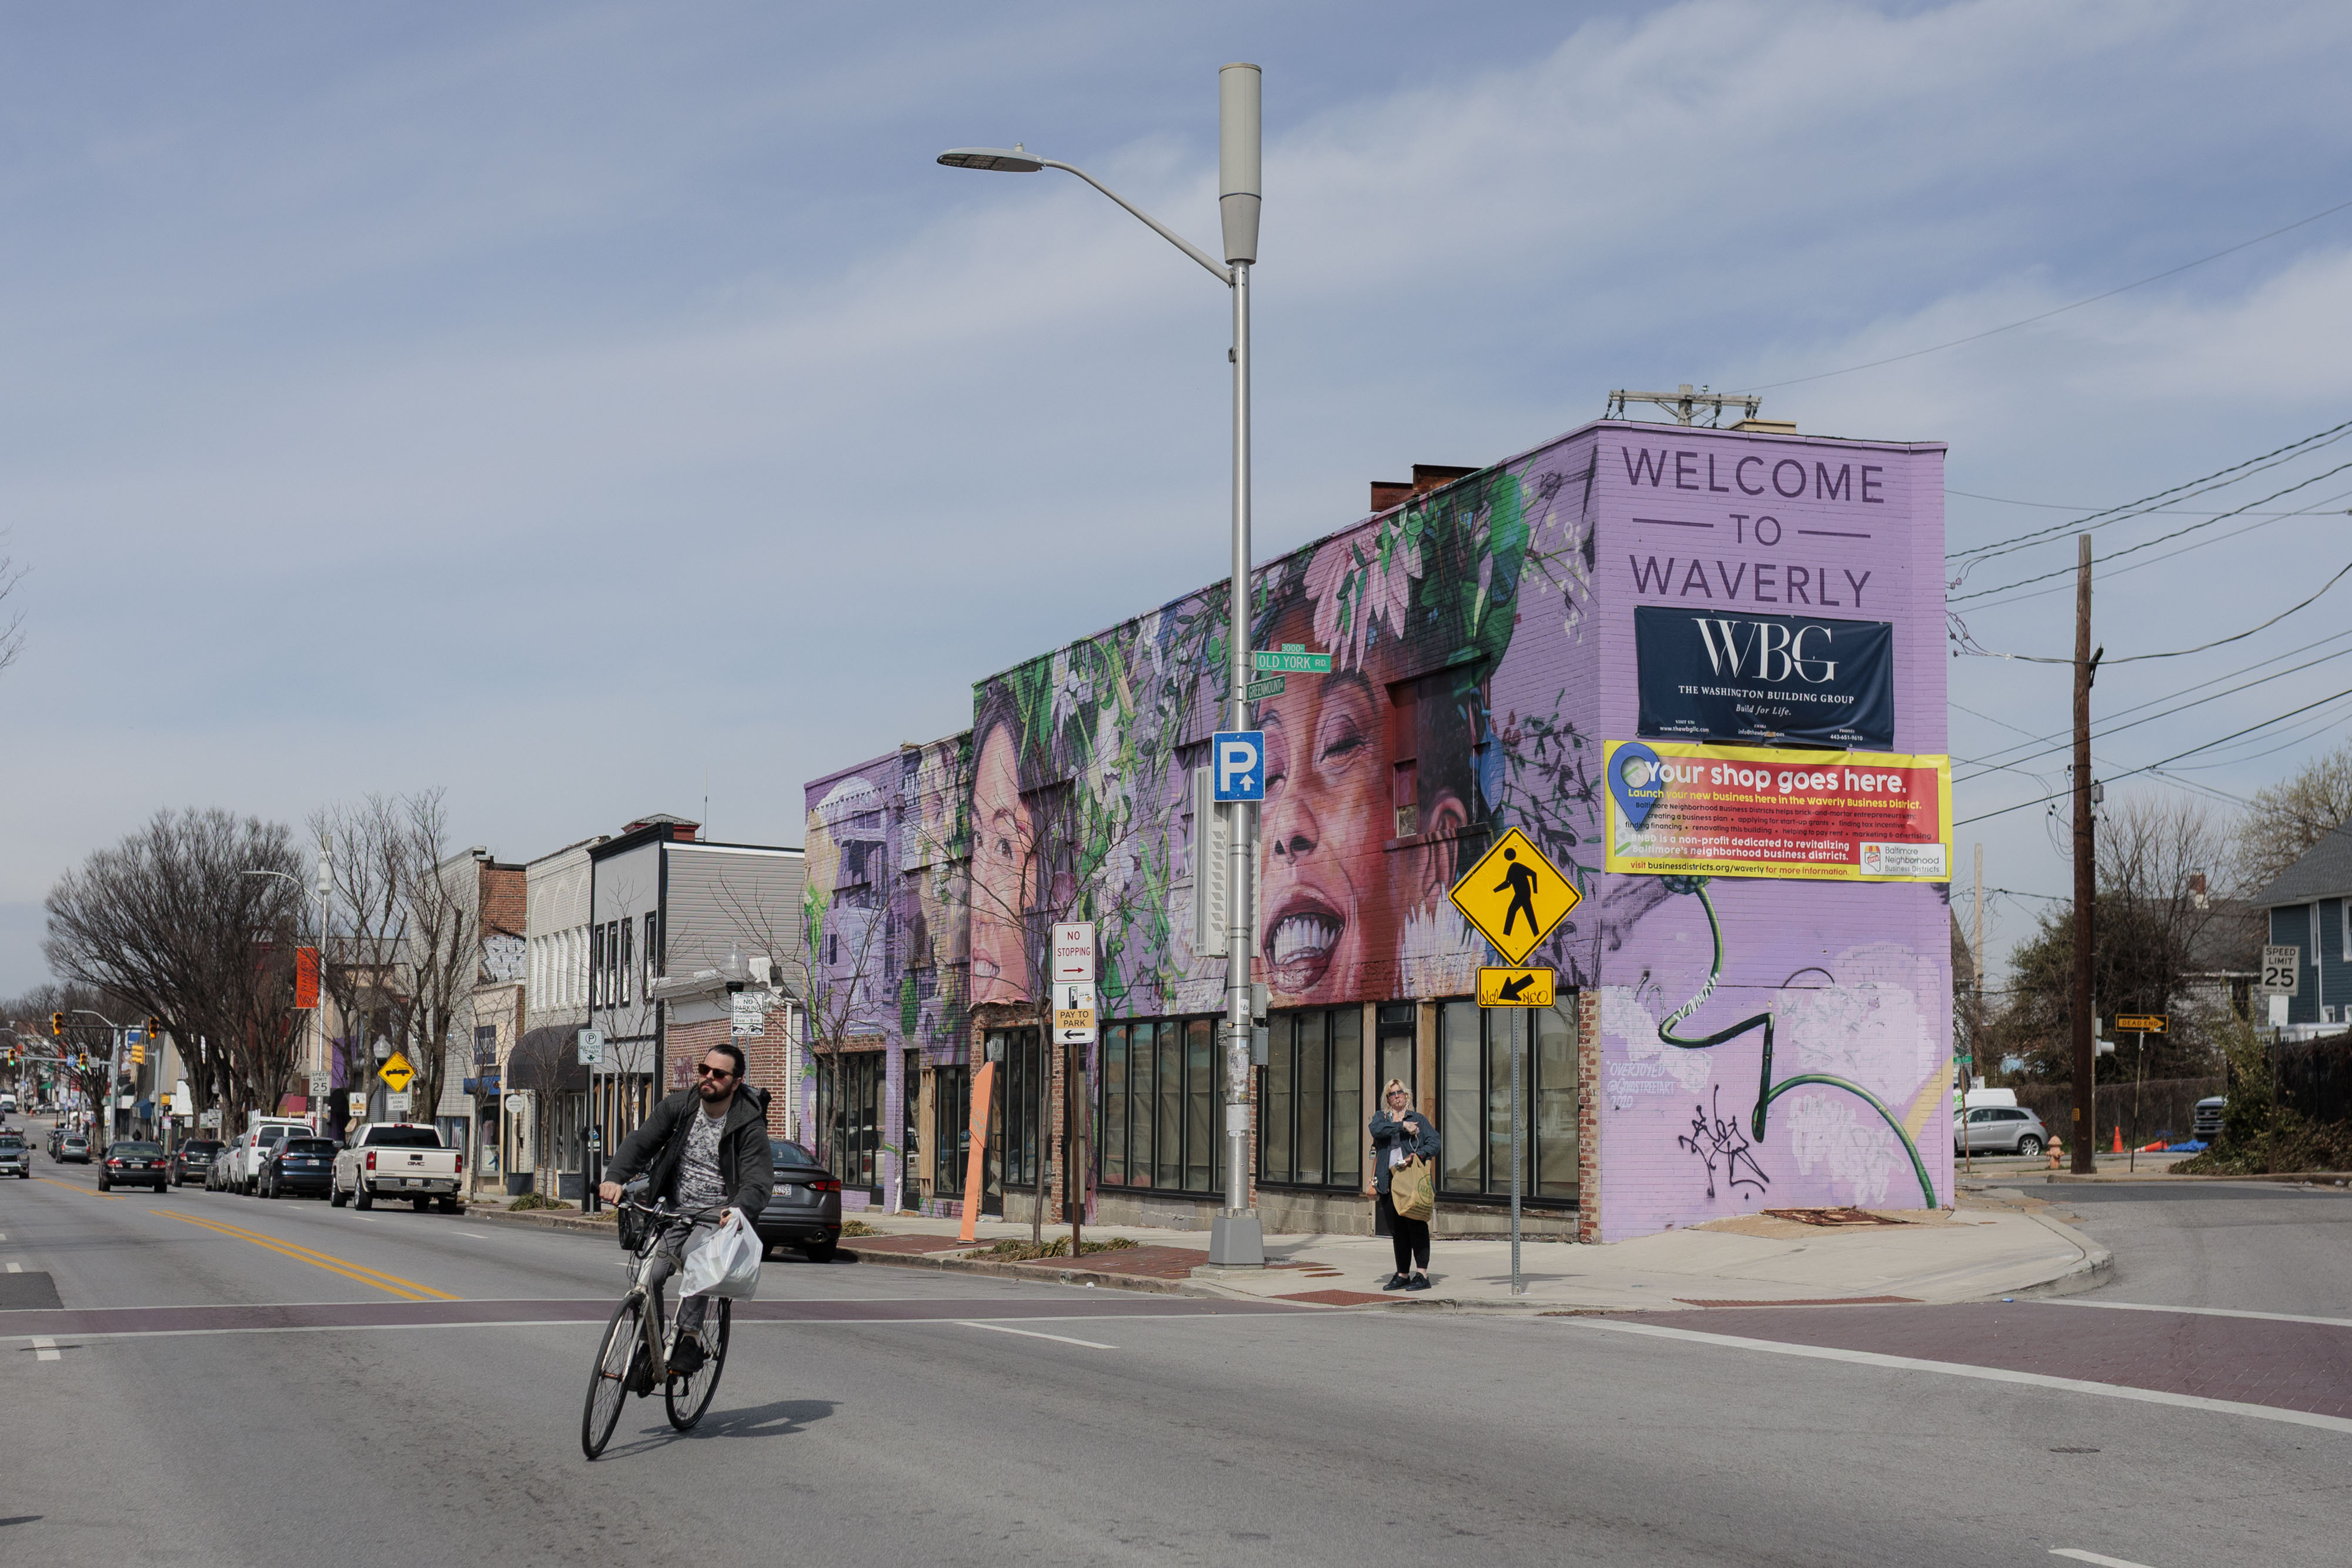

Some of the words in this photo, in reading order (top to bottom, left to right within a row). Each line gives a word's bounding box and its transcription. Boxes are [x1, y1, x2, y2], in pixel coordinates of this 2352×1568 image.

[1622, 447, 1884, 503] WELCOME
[1729, 514, 1781, 546] TO
[1629, 555, 1871, 608] WAVERLY
[1691, 618, 1839, 683] WBG
[1259, 655, 1279, 668] OLD
[1283, 656, 1311, 669] YORK
[1248, 679, 1281, 698] GREENMOUNT
[1678, 686, 1698, 694] THE
[1701, 687, 1763, 699] WASHINGTON
[1767, 691, 1817, 702] BUILDING
[1820, 695, 1854, 704] GROUP
[1736, 704, 1754, 713] Build
[1755, 706, 1769, 716] for
[1772, 707, 1791, 717] Life.
[1220, 741, 1258, 792] P
[1645, 761, 1705, 784] Your
[1711, 763, 1771, 792] shop
[1778, 771, 1839, 794] goes
[1845, 768, 1906, 793] here.
[1628, 789, 1664, 798] Launch
[1666, 791, 1687, 800] your
[1713, 791, 1753, 802] business
[1755, 794, 1776, 804] here
[1779, 795, 1788, 804] in
[1789, 795, 1805, 805] the
[1806, 797, 1845, 808] Waverly
[1847, 798, 1887, 808] Business
[1889, 799, 1922, 809] District.
[1743, 826, 1772, 834] building
[1782, 828, 1807, 836] helping
[1852, 831, 1887, 839] marketing
[1631, 834, 1656, 842] BNBD
[1659, 834, 1668, 842] is
[1679, 835, 1729, 845] non-profit
[1732, 837, 1781, 847] dedicated
[1784, 839, 1793, 848] to
[1796, 840, 1849, 851] revitalizing
[1632, 844, 1688, 855] Baltimore's
[1690, 847, 1761, 857] neighborhood
[1763, 849, 1806, 859] business
[1808, 850, 1849, 861] districts.
[1885, 847, 1918, 855] Baltimore
[1867, 855, 1879, 863] OPEN
[1885, 856, 1939, 865] Neighborhood
[1631, 860, 1646, 869] visit
[1648, 861, 1764, 874] businessdistricts.org/waverly
[1766, 865, 1777, 874] for
[1802, 867, 1849, 875] information.
[1067, 931, 1080, 941] NO
[1057, 947, 1091, 957] STOPPING
[2266, 947, 2296, 956] SPEED
[2264, 967, 2294, 988] 25
[1060, 1011, 1075, 1019] PAY
[1078, 1010, 1089, 1018] TO
[1063, 1019, 1085, 1028] PARK
[313, 1083, 328, 1092] 25
